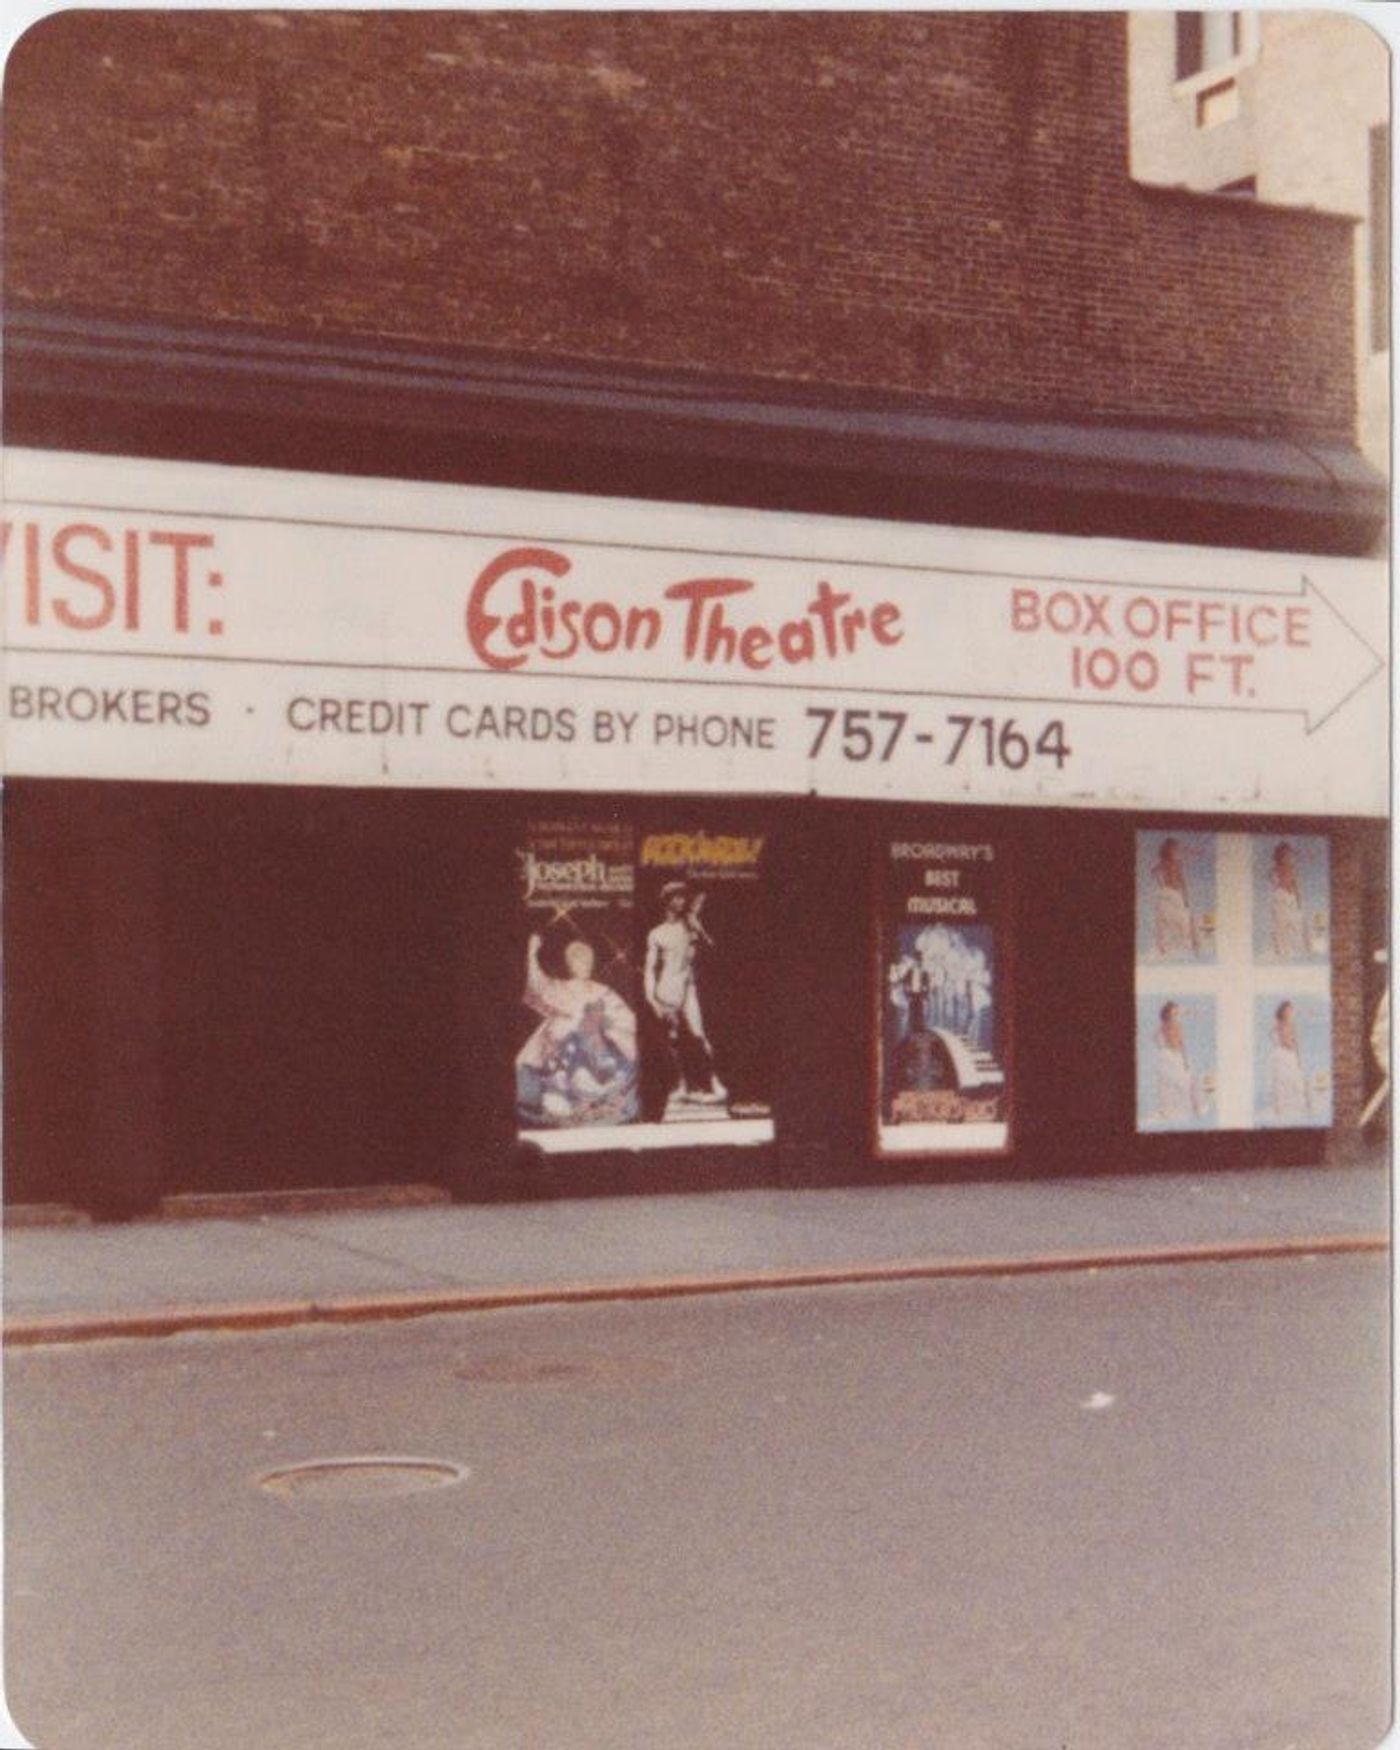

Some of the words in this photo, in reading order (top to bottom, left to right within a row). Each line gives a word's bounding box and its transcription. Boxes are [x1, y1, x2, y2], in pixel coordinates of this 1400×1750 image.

[1, 522, 224, 636] ISIT:
[466, 547, 662, 671] Edison
[664, 577, 904, 670] Theatre
[1010, 588, 1111, 636] BOX
[1124, 596, 1311, 647] OFFICE
[1072, 646, 1159, 692] 100
[1187, 653, 1255, 698] FT.
[9, 685, 211, 727] BROKERS
[287, 698, 430, 736] CREDIT
[446, 703, 577, 743] CARDS
[593, 710, 638, 744] BY
[654, 714, 777, 749] PHONE
[806, 707, 1072, 770] 757-7164
[924, 869, 960, 888] BEST
